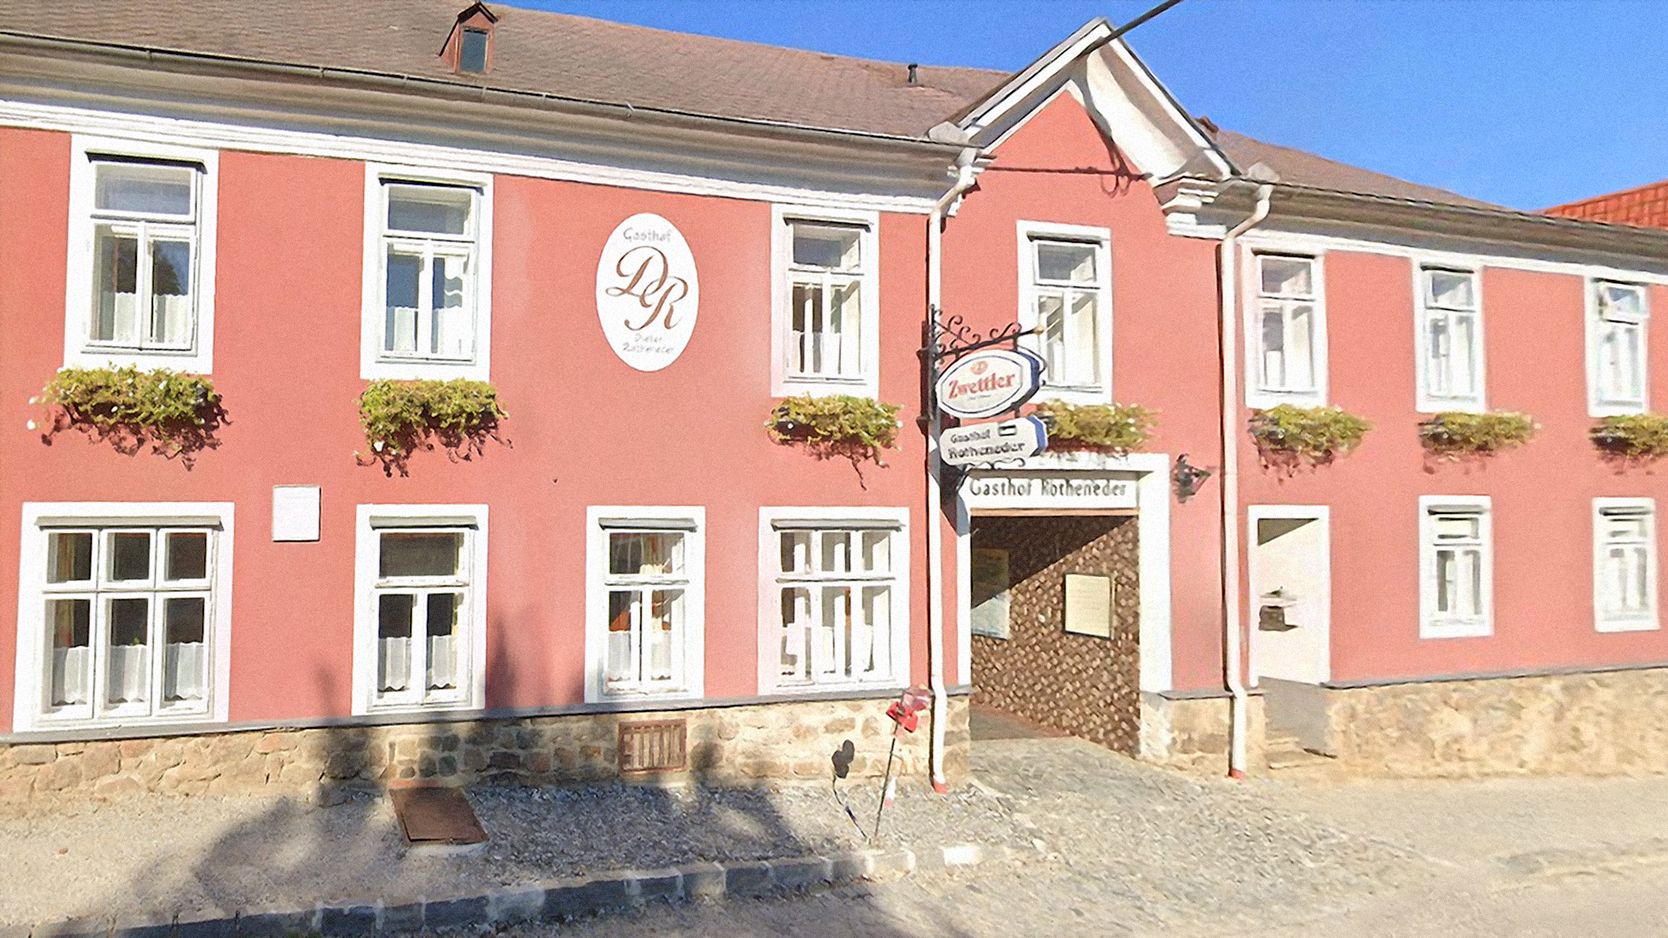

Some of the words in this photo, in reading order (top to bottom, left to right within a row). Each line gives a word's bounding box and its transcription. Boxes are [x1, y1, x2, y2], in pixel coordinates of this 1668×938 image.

[623, 227, 673, 243] Gasthof
[948, 373, 1016, 399] Zwettler
[950, 429, 991, 443] Gasthof
[948, 442, 1026, 459] Rotheneder
[969, 477, 1032, 497] Gasthof
[1041, 477, 1128, 497] Rotheneder
